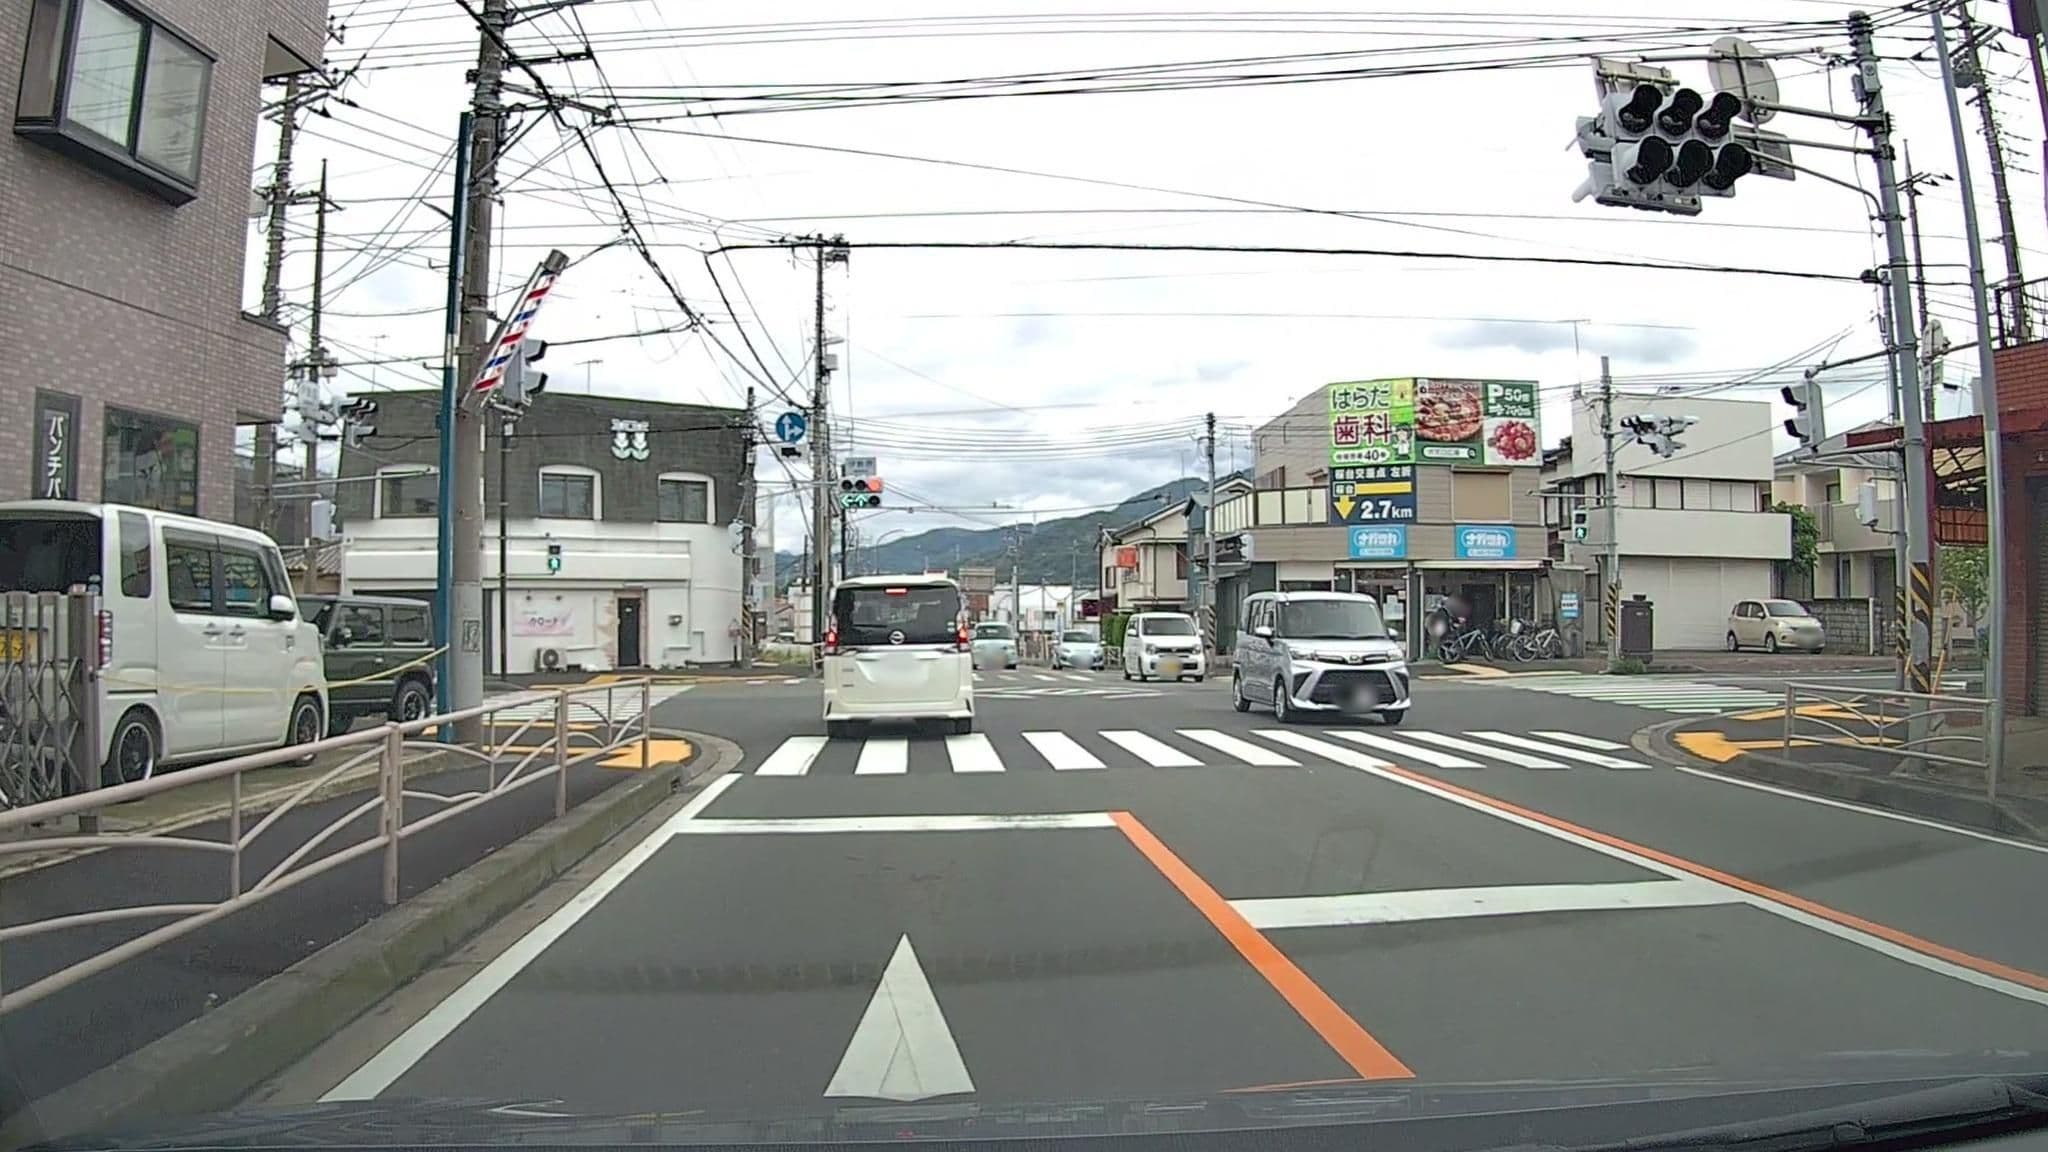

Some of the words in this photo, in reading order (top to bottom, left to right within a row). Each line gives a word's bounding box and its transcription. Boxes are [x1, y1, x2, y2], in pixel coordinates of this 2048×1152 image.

[1333, 386, 1389, 409] はらだ
[1335, 415, 1391, 445] 歯科
